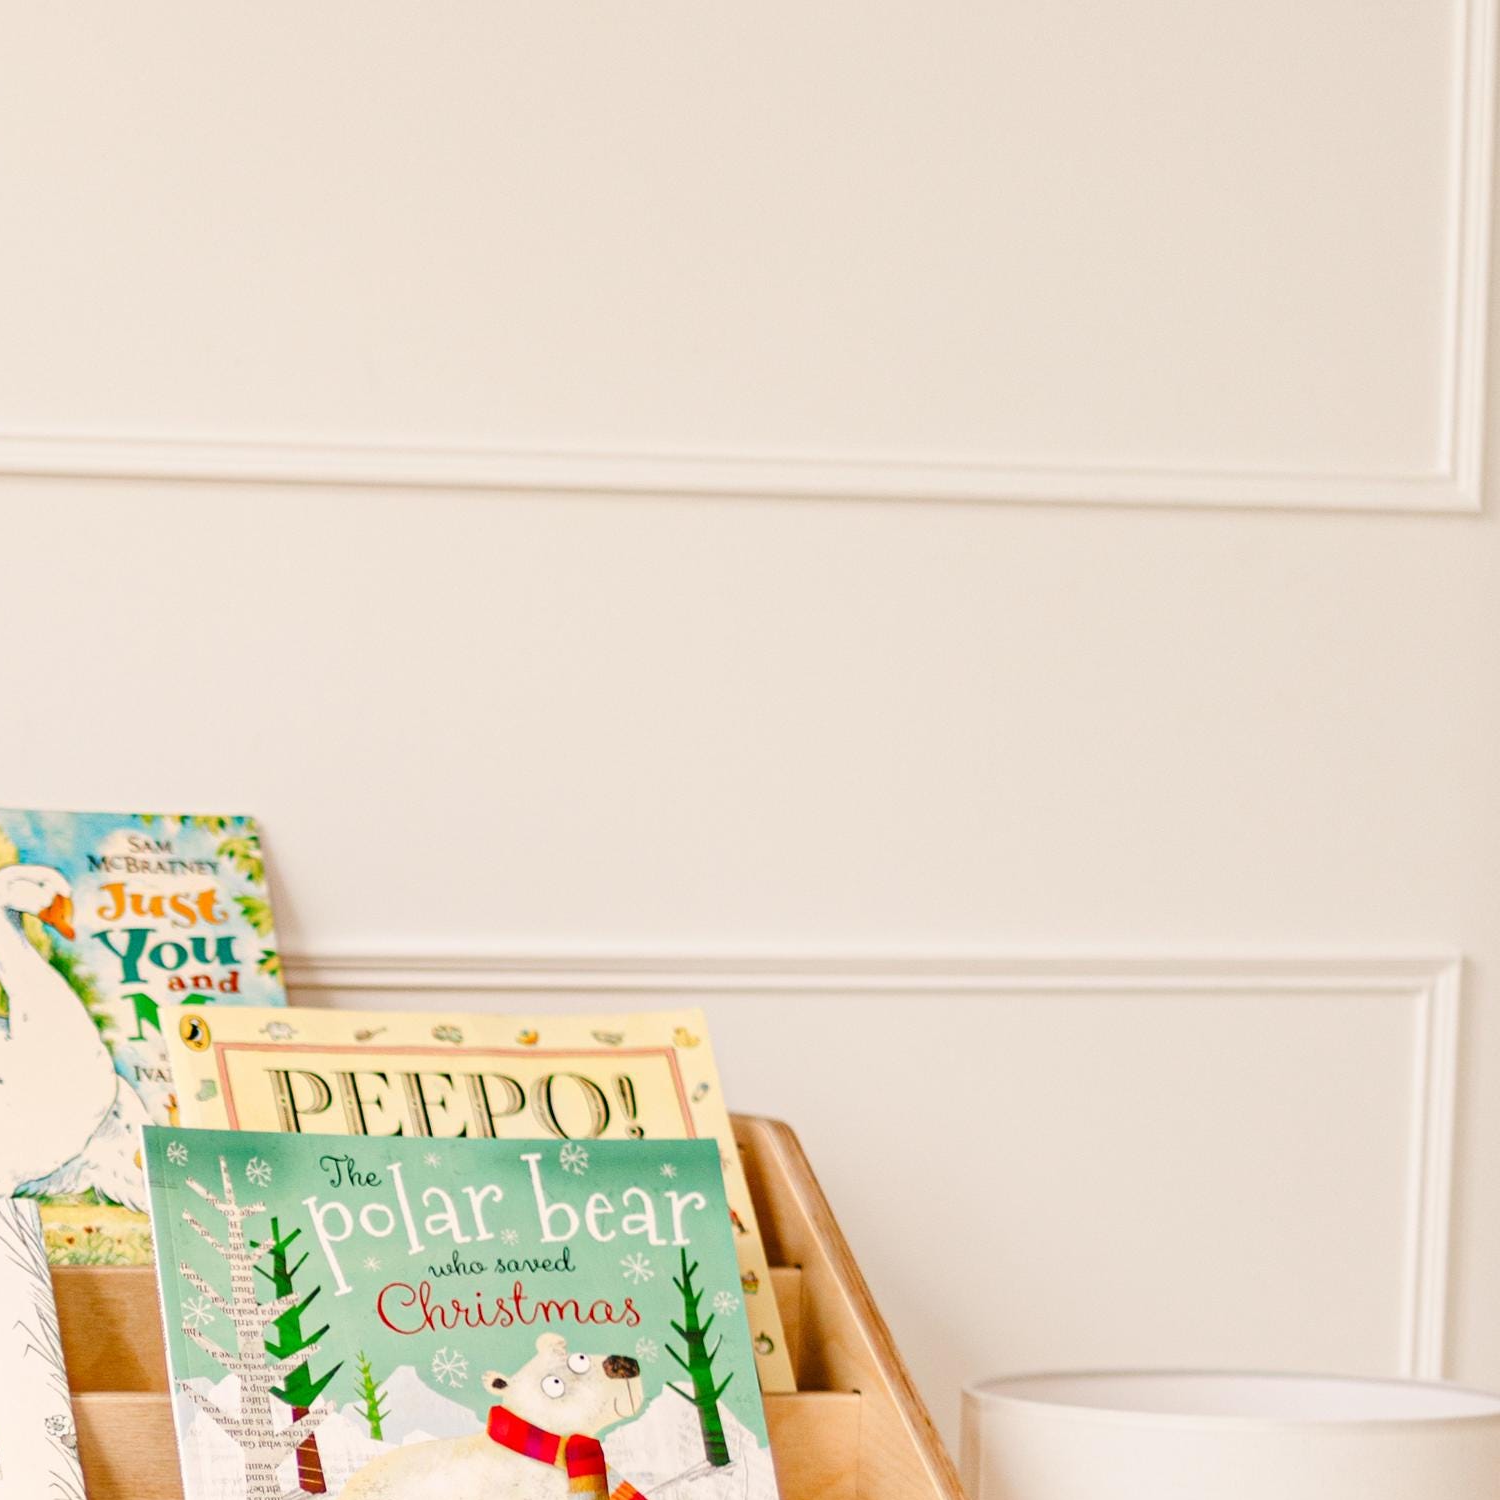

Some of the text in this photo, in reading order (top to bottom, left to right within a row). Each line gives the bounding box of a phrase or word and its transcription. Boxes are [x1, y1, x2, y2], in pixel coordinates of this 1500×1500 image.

[96, 882, 229, 929] Just
[90, 928, 242, 984] You
[167, 969, 241, 994] and
[262, 1068, 645, 1141] PEEPO!
[319, 1154, 382, 1189] The
[302, 1161, 504, 1297] polar
[520, 1152, 707, 1247] bear
[428, 1246, 577, 1278] who saved
[376, 1280, 642, 1336] Christmas
